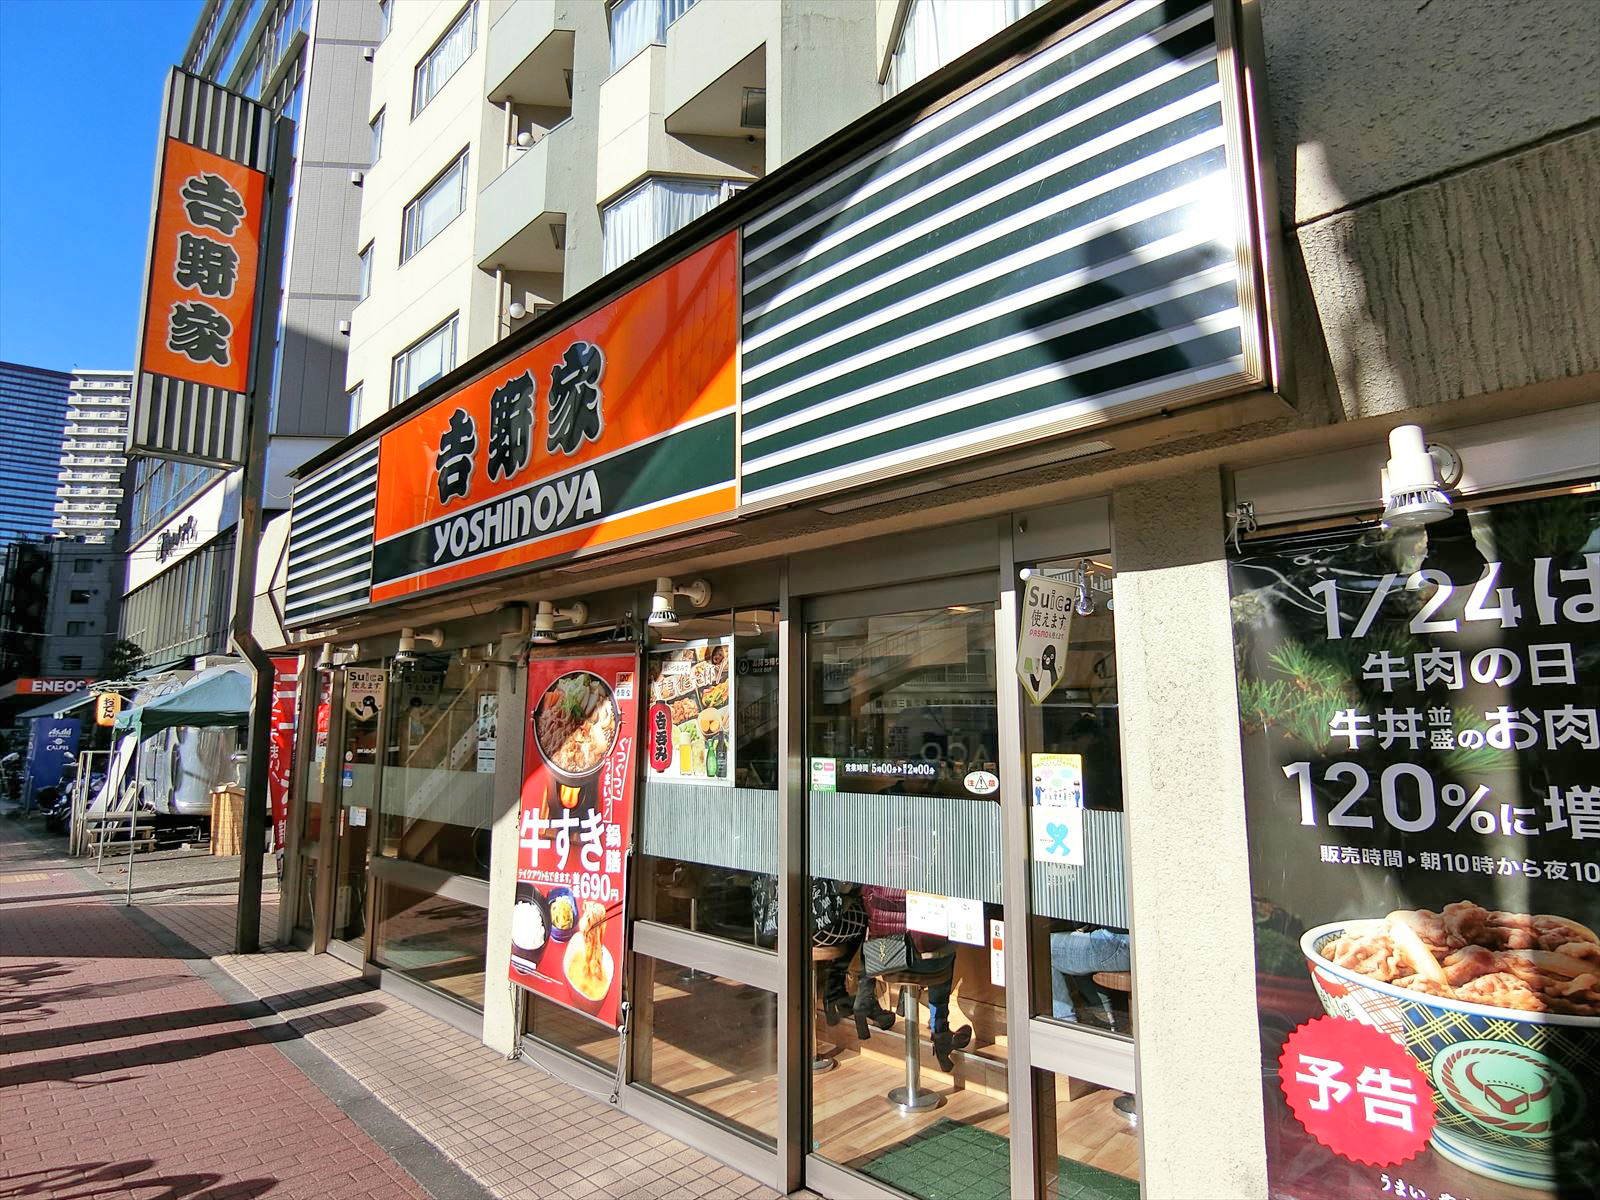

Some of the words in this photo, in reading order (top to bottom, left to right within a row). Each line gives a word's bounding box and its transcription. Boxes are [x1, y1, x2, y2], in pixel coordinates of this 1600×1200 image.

[166, 170, 248, 368] 吉野家
[435, 340, 606, 506] 吉野家
[433, 469, 602, 563] YOSHINOYA
[1029, 586, 1072, 612] Suica
[32, 680, 85, 692] ENEOS
[350, 672, 384, 681] Suica
[1362, 643, 1576, 692] 牛肉の日
[49, 728, 72, 737] Asahi
[519, 807, 605, 872] 牛すき
[1320, 845, 1403, 868] 販売時間
[1295, 1053, 1418, 1132] 予告
